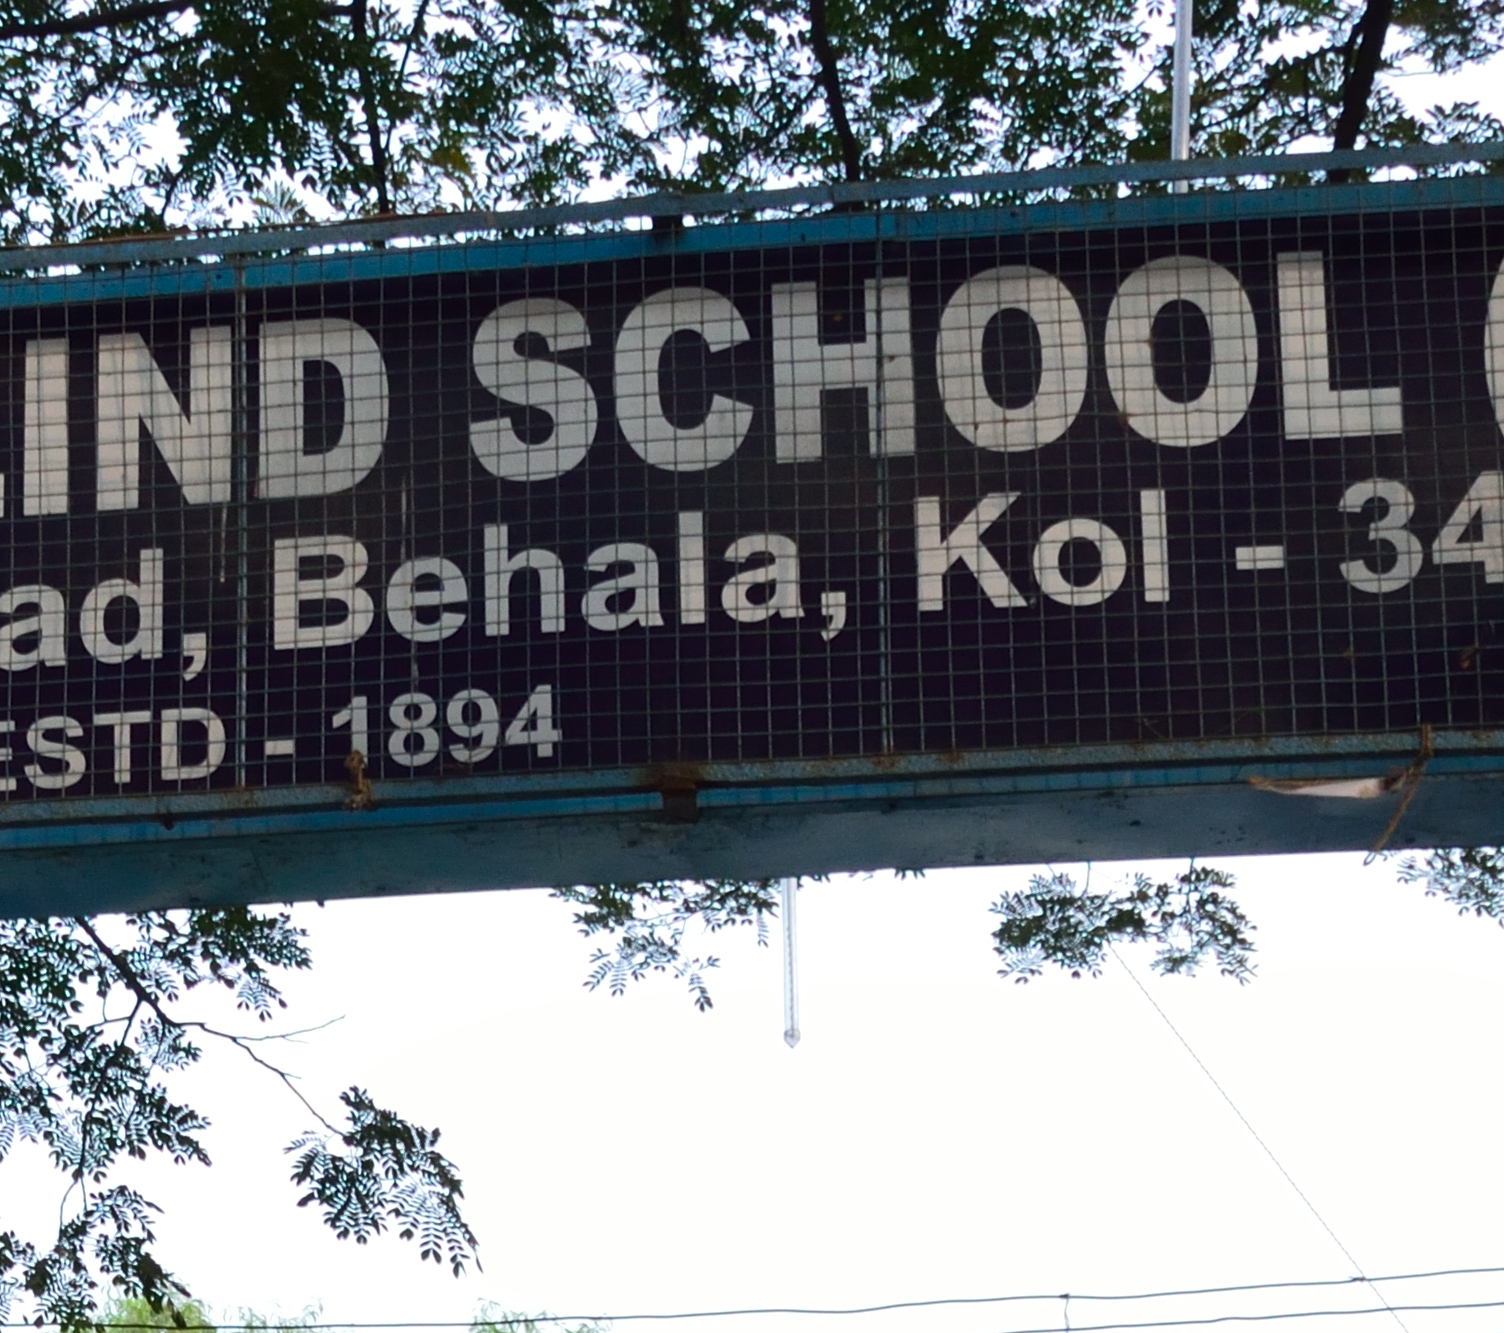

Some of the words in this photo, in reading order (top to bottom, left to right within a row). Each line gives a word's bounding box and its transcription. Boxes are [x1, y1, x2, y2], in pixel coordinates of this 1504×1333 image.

[467, 250, 1402, 482] SCHOOL
[271, 510, 849, 652] Behala,
[913, 486, 1172, 612] Kol
[330, 684, 563, 769] 1894
